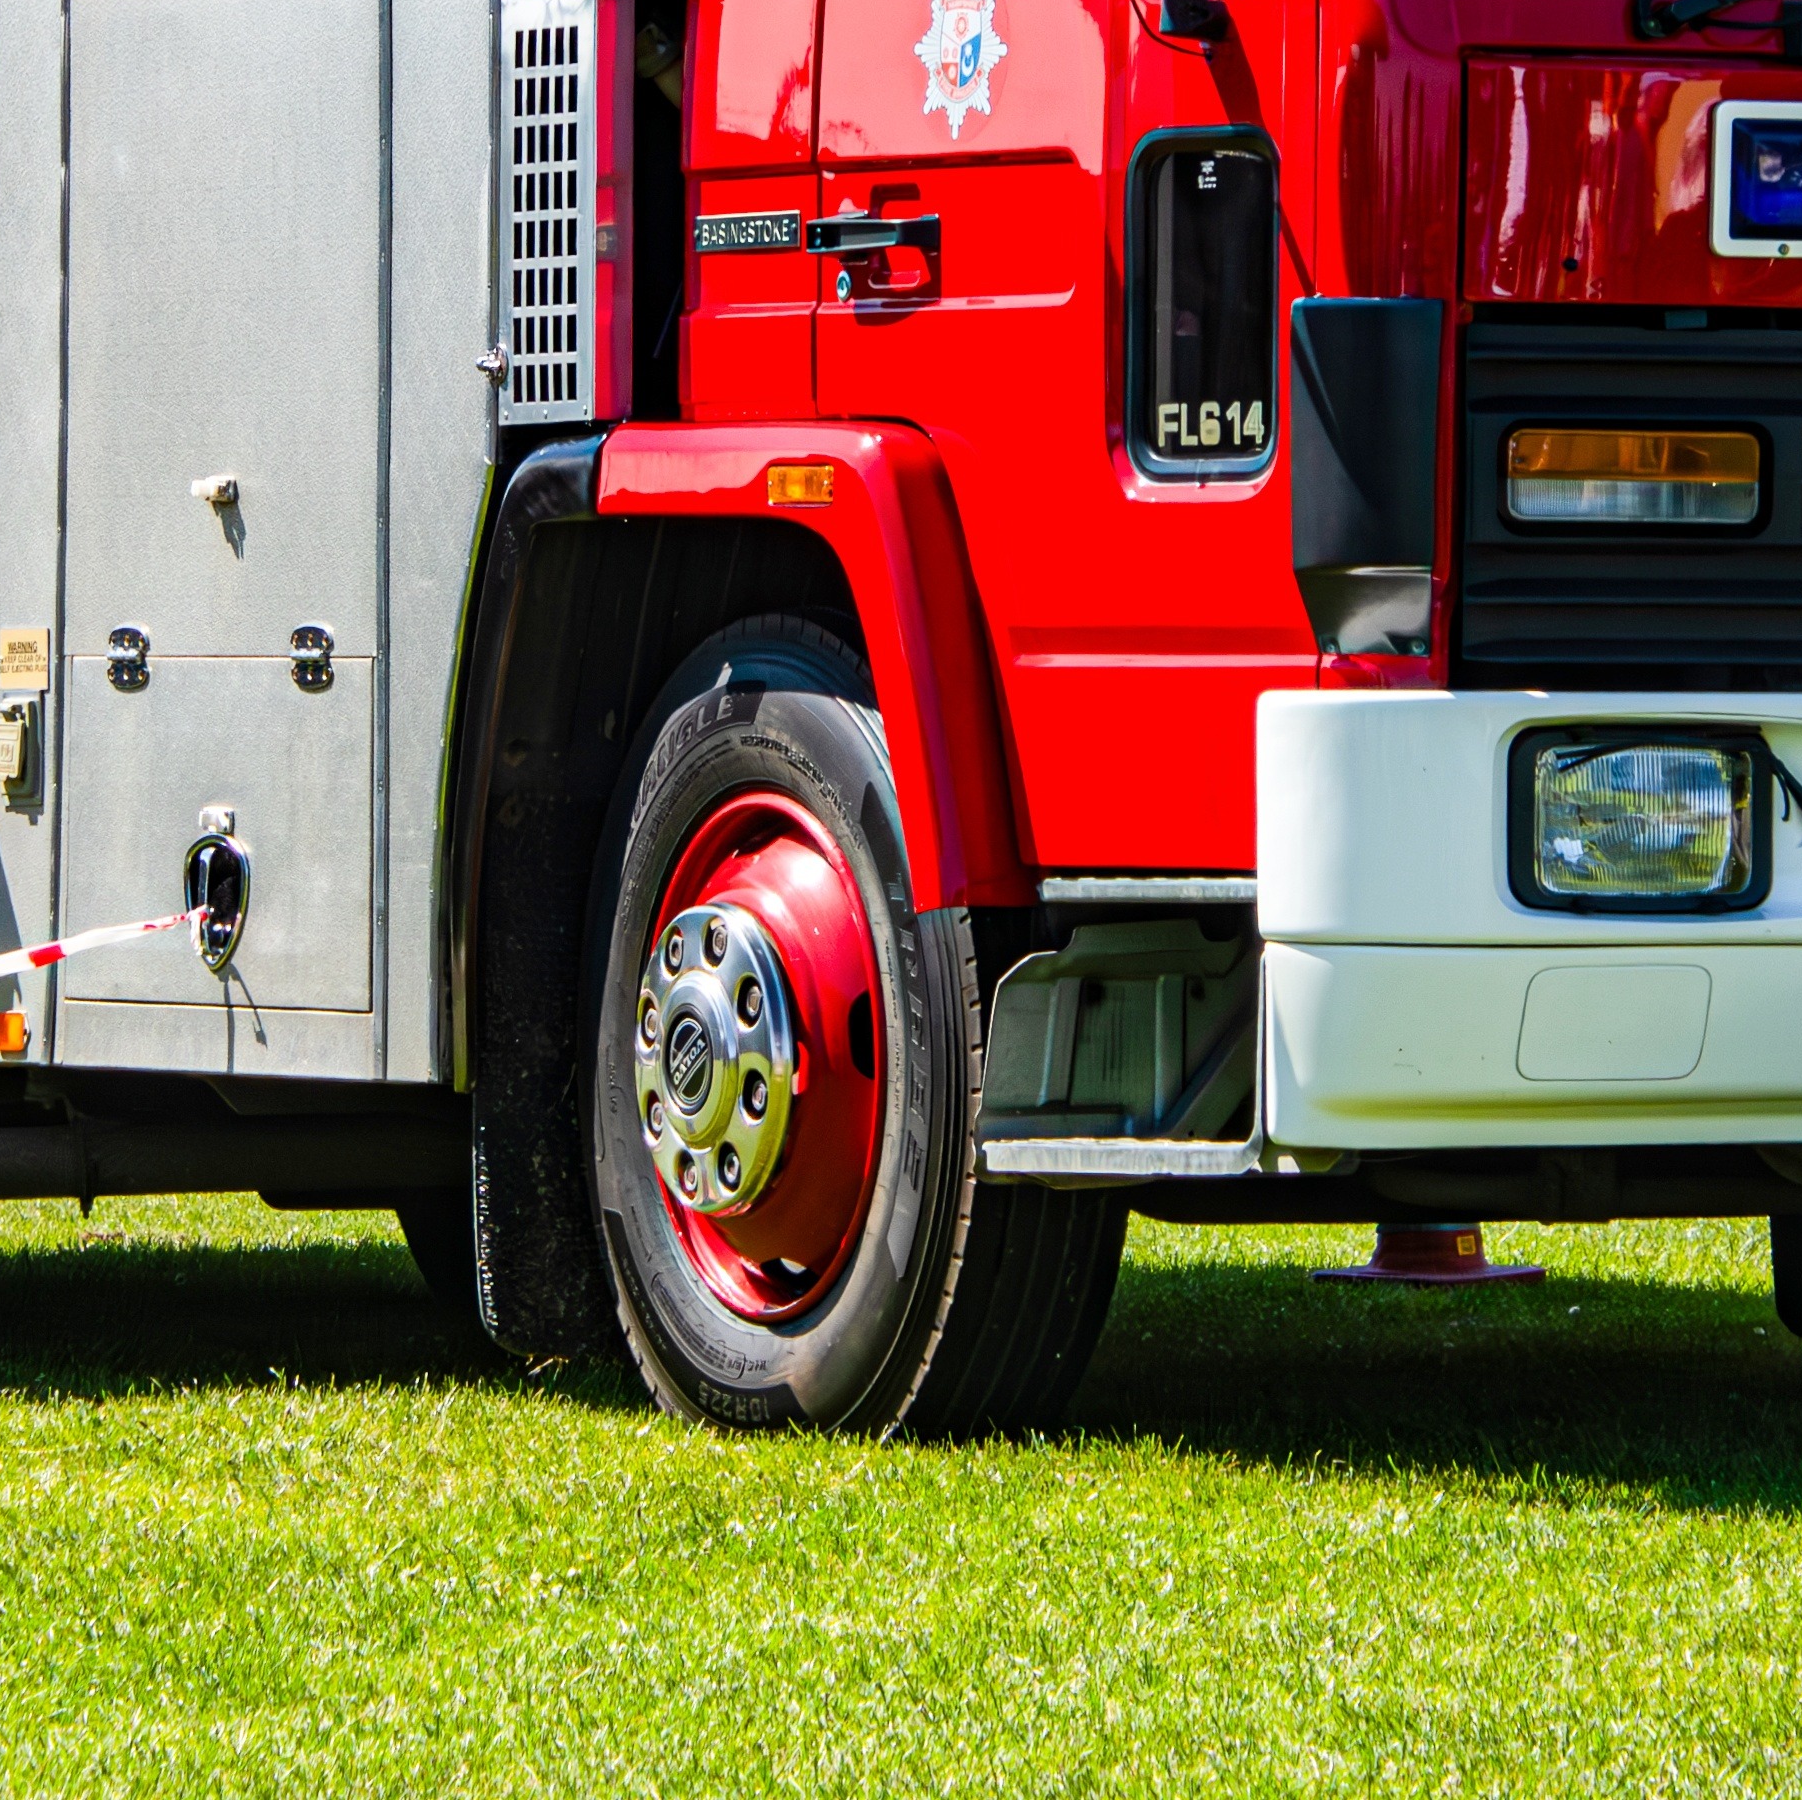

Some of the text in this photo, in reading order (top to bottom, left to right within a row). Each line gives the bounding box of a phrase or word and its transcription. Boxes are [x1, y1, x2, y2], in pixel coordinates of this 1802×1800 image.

[701, 218, 790, 247] BASINGSTOKE
[8, 641, 38, 654] WARNING
[18, 655, 33, 663] CLEAR
